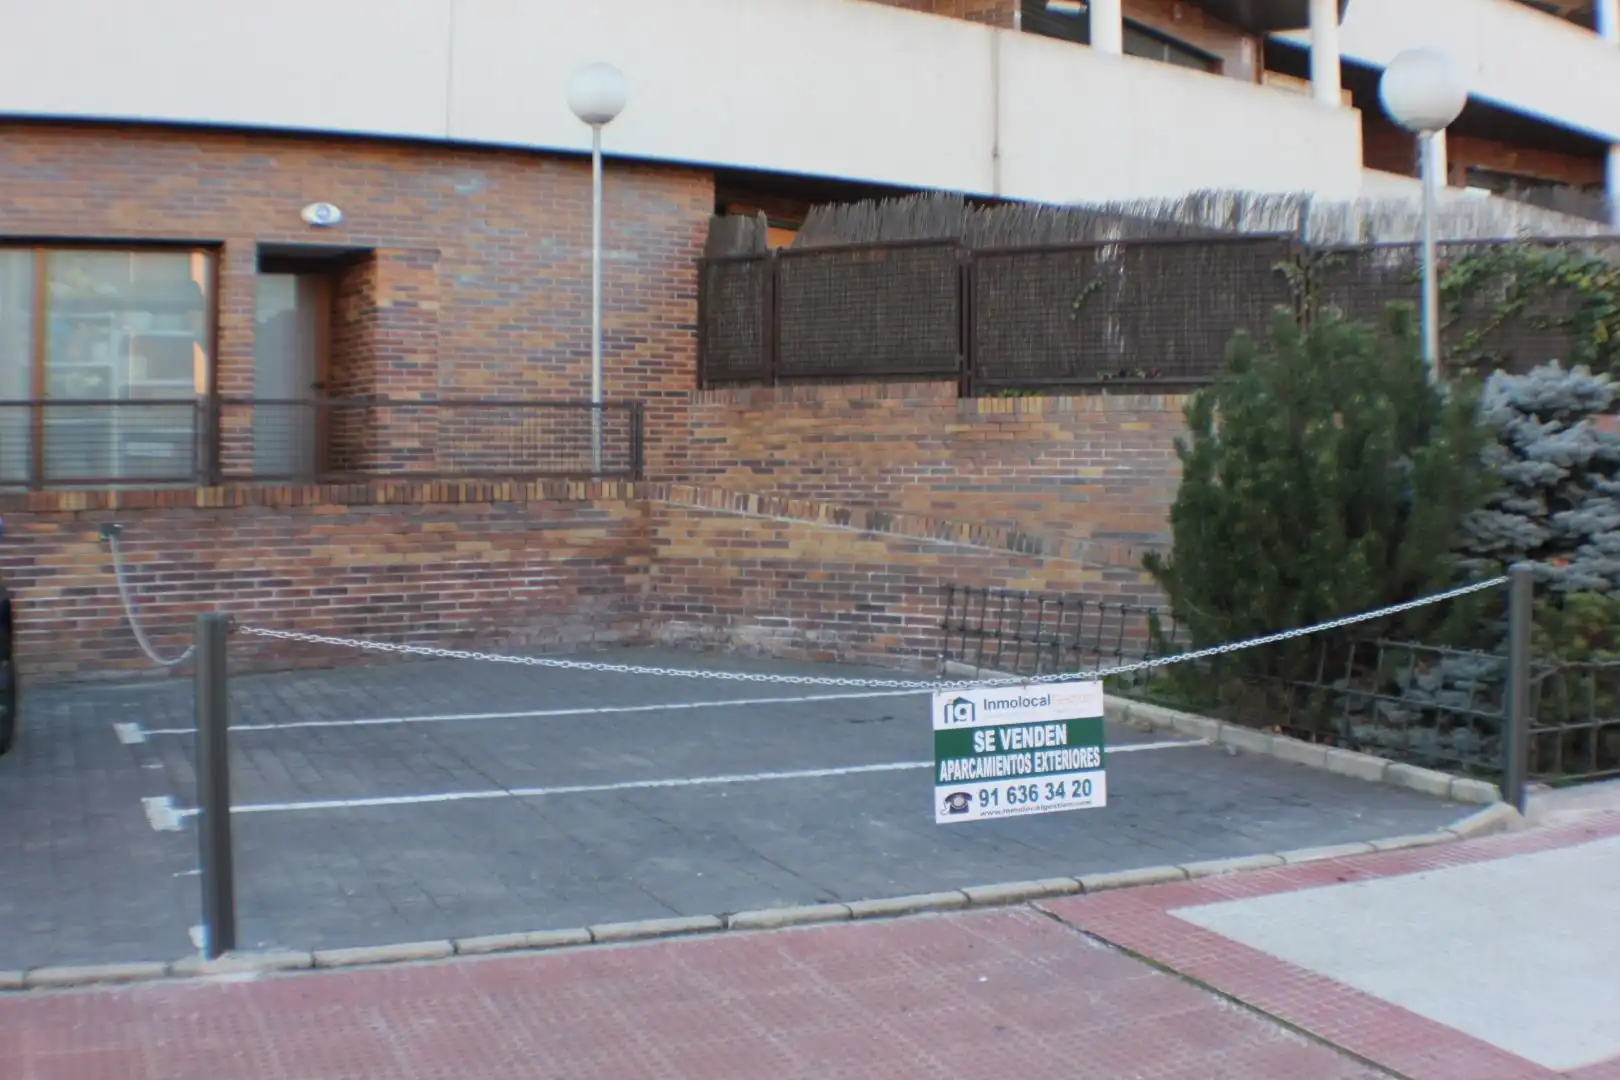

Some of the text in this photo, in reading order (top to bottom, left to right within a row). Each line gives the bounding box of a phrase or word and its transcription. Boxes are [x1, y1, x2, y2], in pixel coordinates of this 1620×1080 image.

[983, 694, 1051, 711] Inmolocal
[974, 724, 1068, 753] SE VENDEN
[940, 747, 1101, 782] APARCAMIENTOS EXTERIORES
[979, 779, 1092, 808] 91 636 34 20
